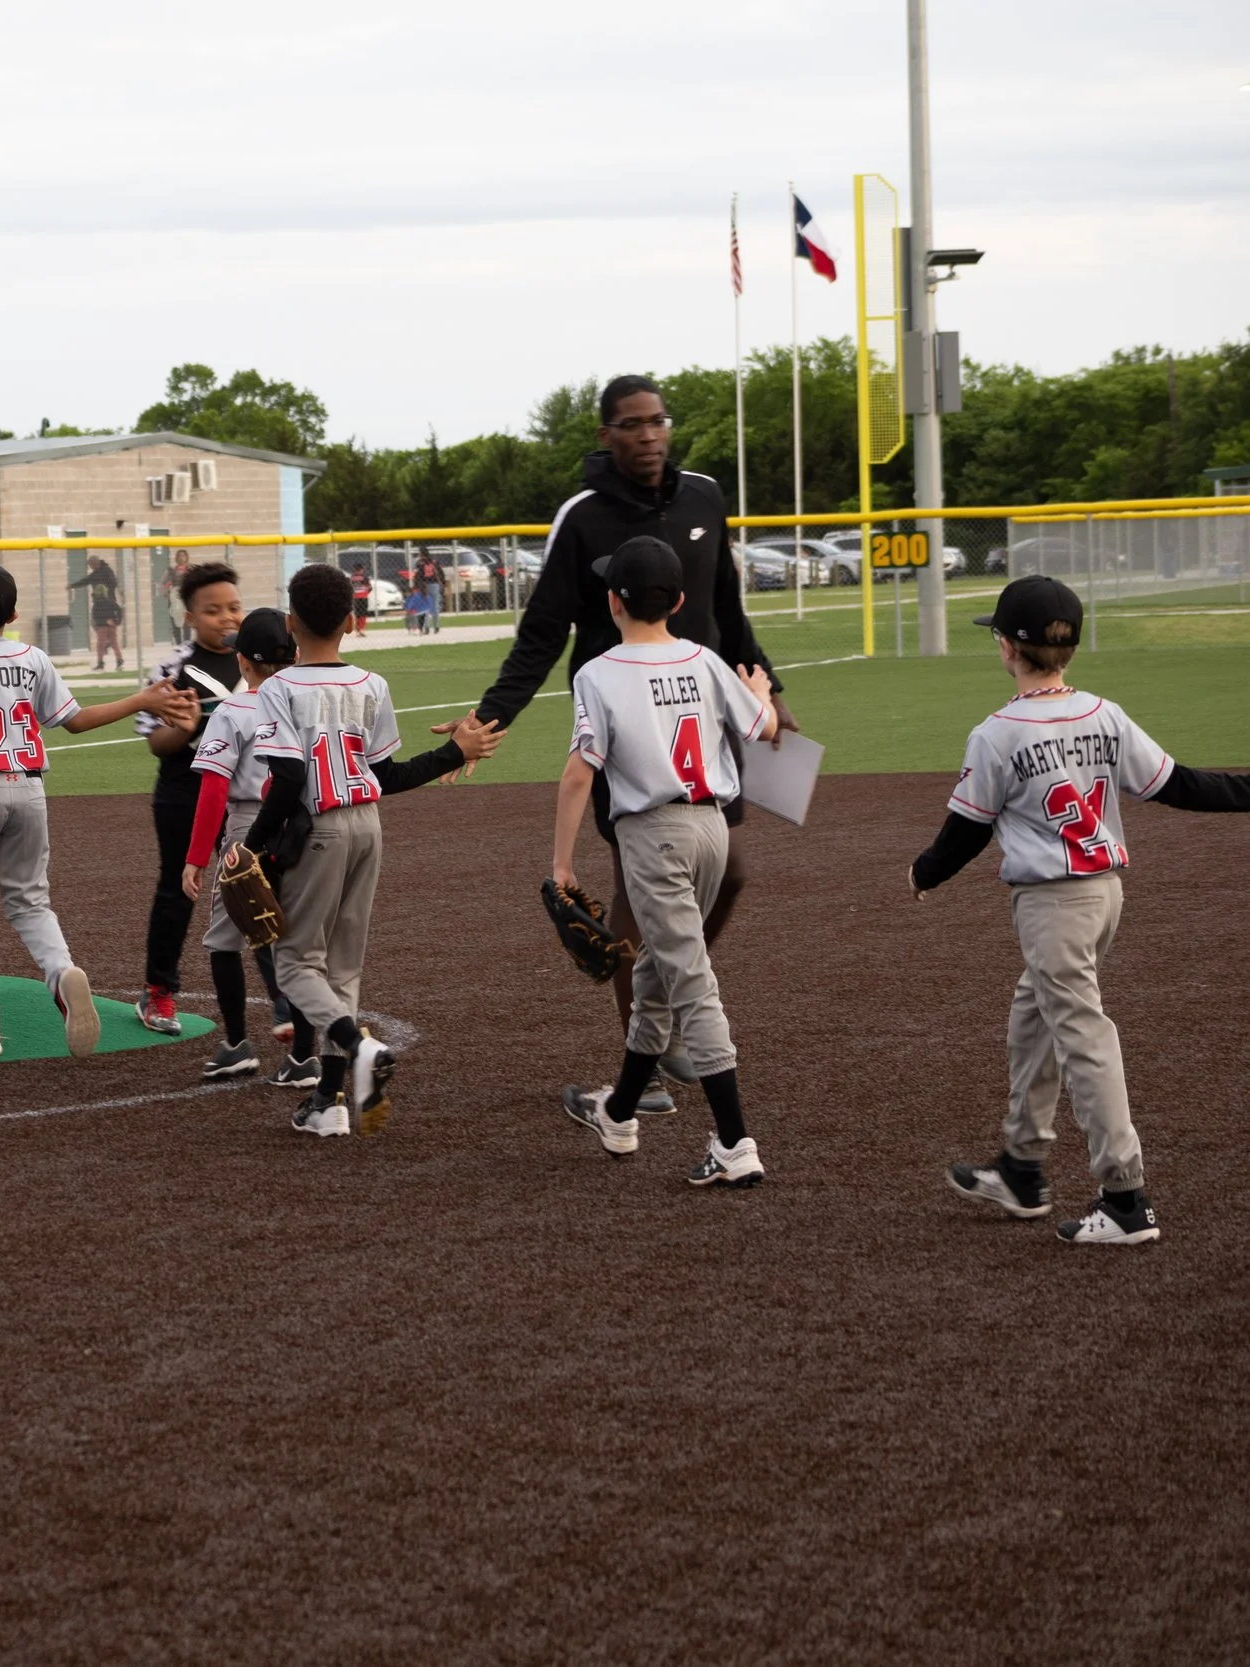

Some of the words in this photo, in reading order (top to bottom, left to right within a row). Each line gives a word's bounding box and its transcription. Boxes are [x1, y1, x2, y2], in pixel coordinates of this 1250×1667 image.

[872, 532, 928, 567] 200
[649, 675, 701, 706] ELLER
[310, 730, 382, 815] 15
[669, 712, 716, 804] 4
[1010, 734, 1120, 782] MARTN-STRD
